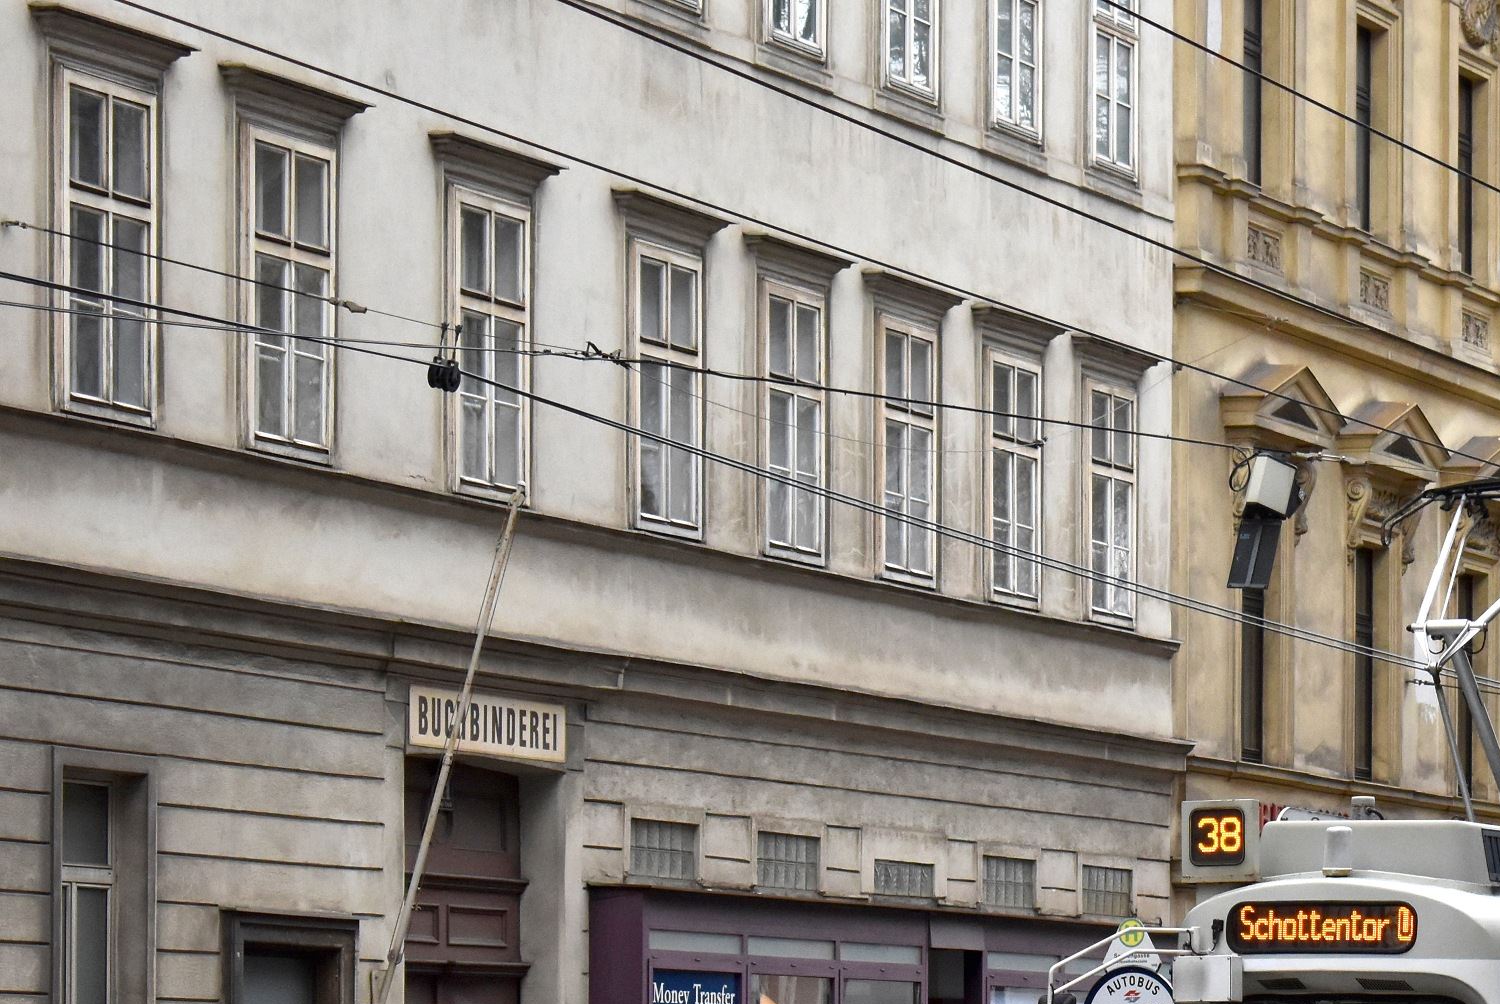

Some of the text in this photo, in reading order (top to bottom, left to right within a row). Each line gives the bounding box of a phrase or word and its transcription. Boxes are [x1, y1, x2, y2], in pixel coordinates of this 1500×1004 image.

[1198, 816, 1241, 853] 38
[1240, 905, 1390, 941] Schottentor
[1106, 975, 1160, 996] AUTOBUS
